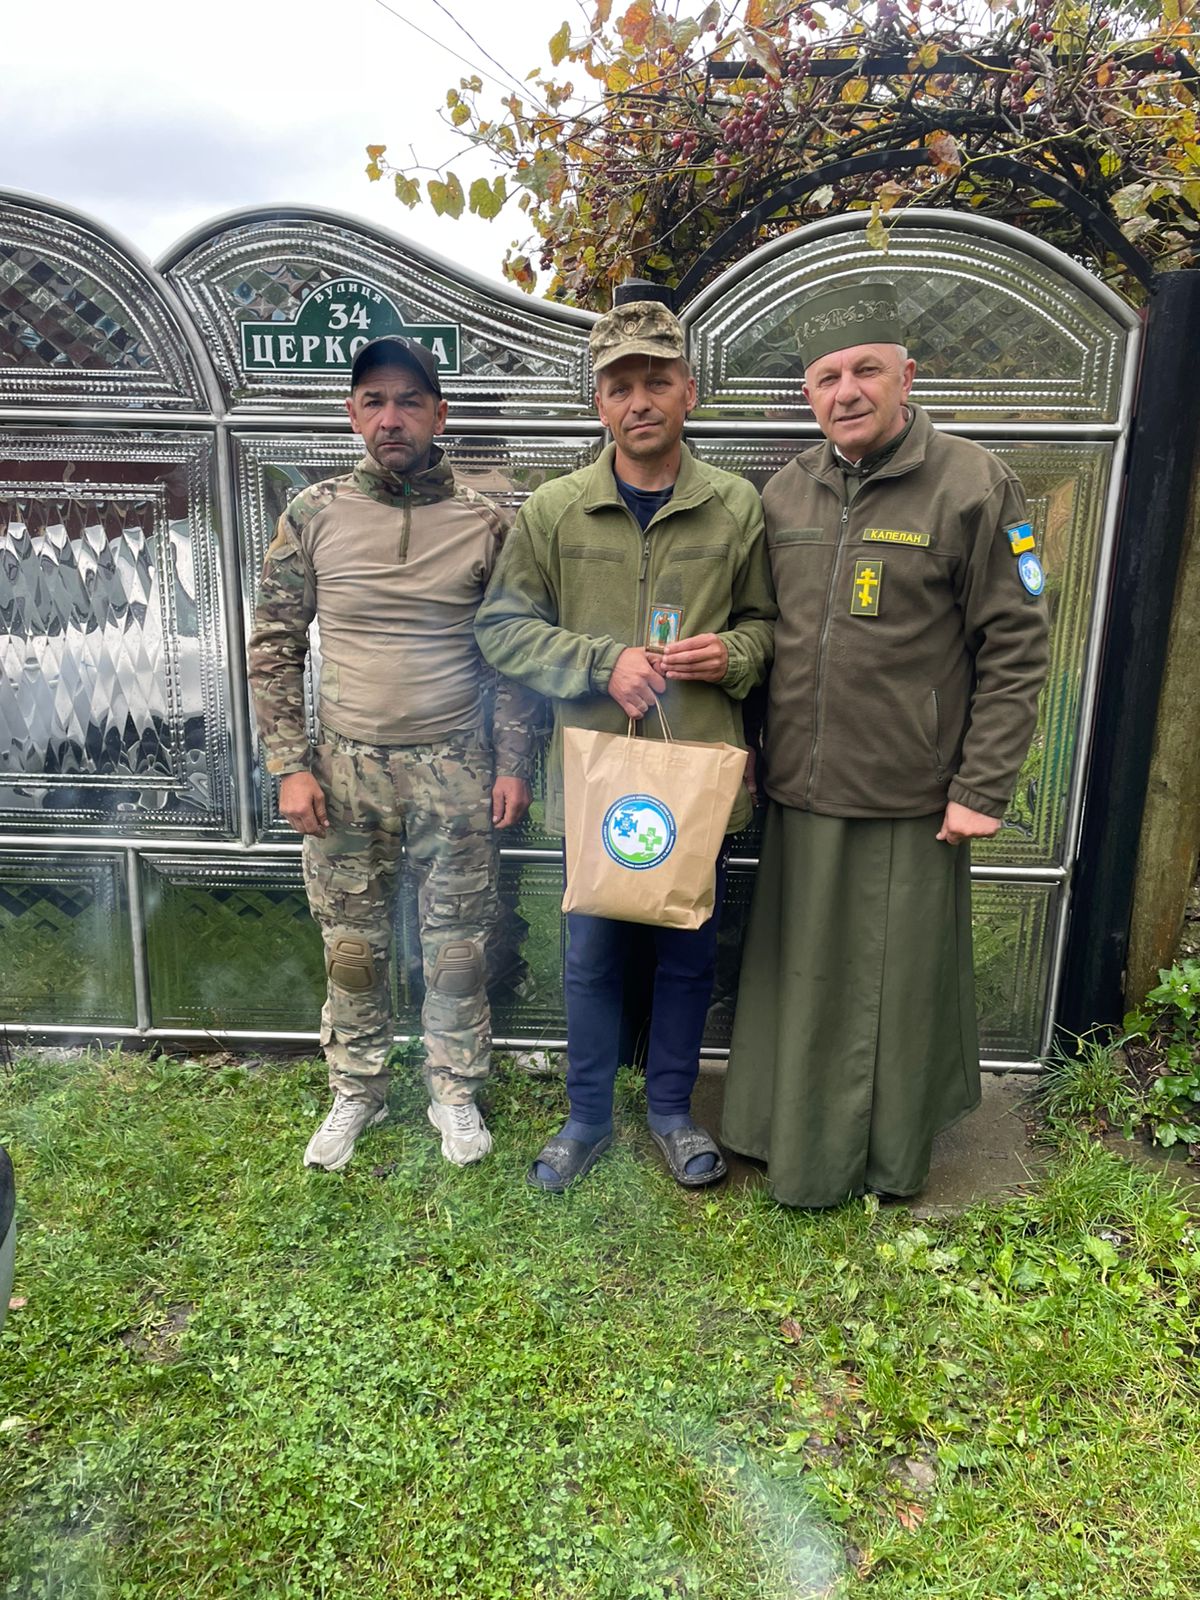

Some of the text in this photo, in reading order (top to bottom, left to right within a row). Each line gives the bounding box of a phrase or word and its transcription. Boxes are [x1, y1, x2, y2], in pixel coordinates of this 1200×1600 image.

[328, 301, 371, 330] 34
[251, 334, 450, 368] ЦЕРКОА
[870, 530, 921, 544] КАПЕЛАН
